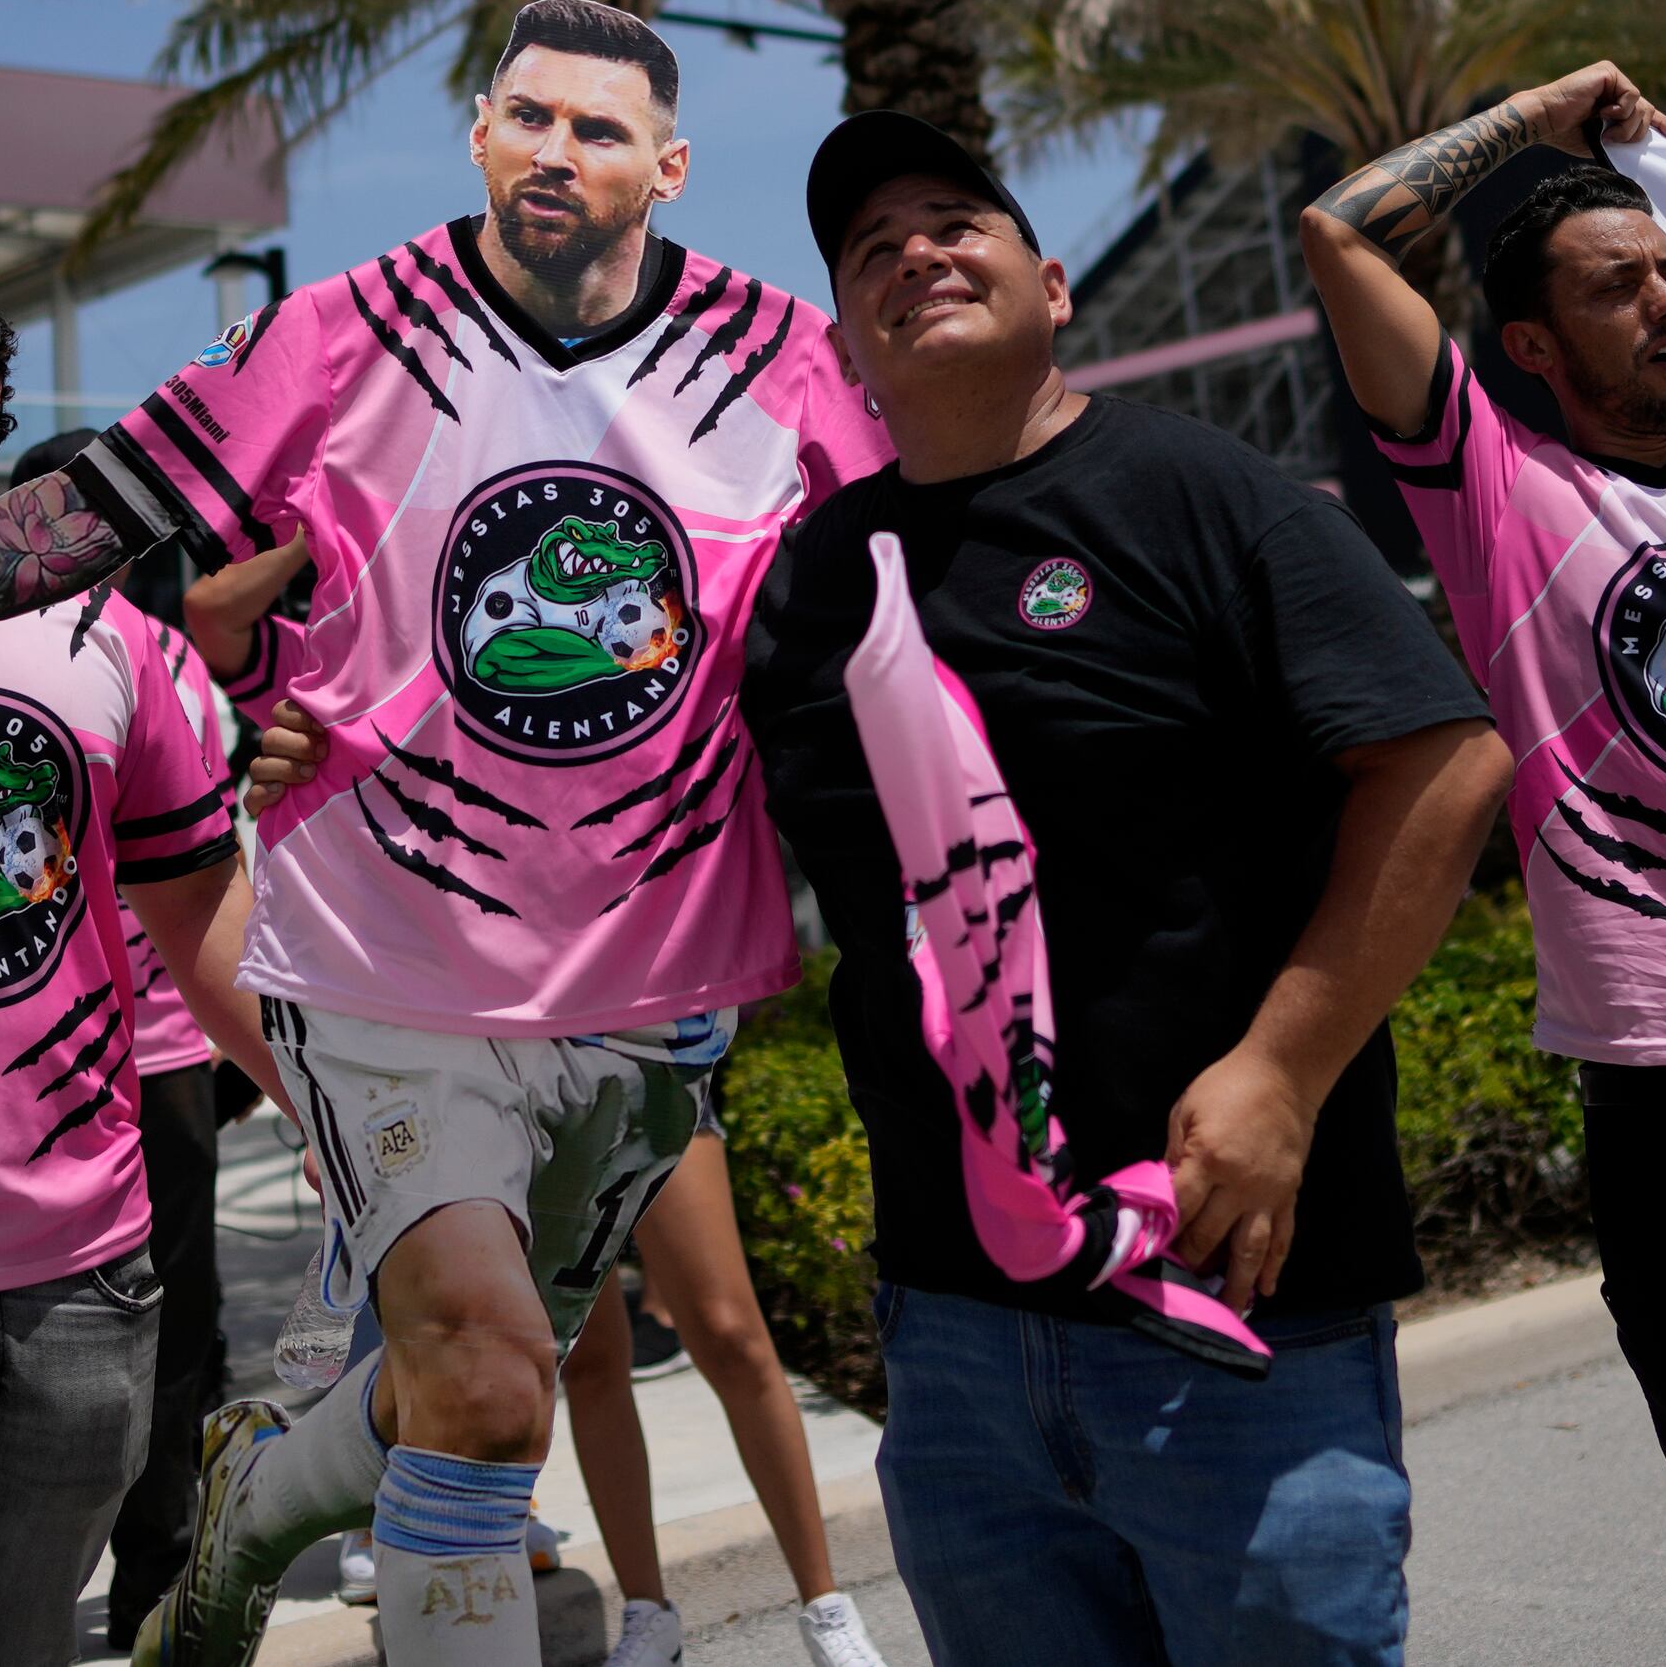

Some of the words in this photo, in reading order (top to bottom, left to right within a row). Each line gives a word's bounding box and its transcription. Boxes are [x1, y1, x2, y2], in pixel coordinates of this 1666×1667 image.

[164, 374, 231, 444] 305Miami
[452, 483, 559, 614] MESSIAS
[589, 487, 652, 534] 305
[574, 608, 590, 628] 10
[494, 627, 690, 740] ALENTANDO
